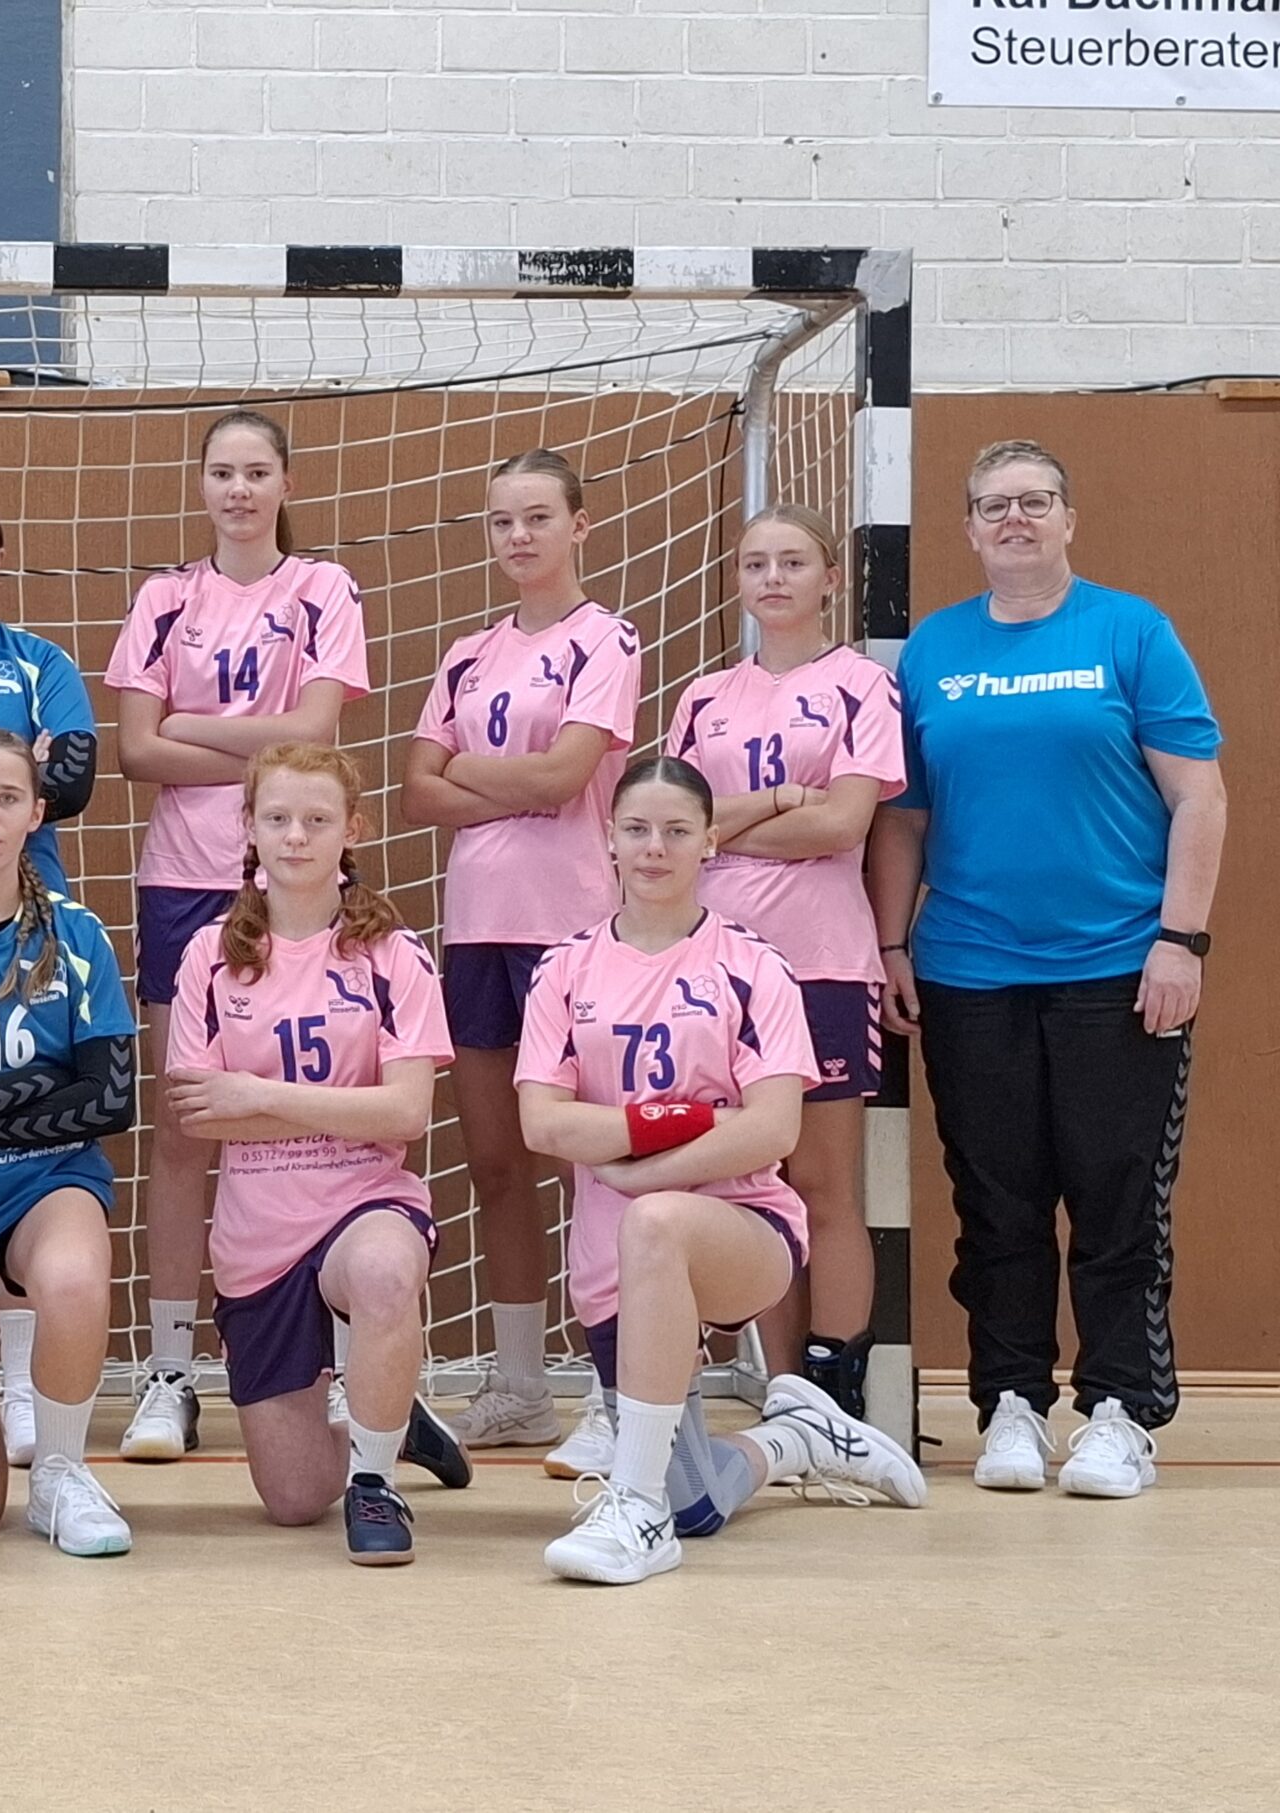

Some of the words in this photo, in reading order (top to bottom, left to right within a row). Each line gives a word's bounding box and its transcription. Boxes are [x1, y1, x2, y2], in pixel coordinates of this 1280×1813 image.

[213, 646, 259, 704] 14
[976, 665, 1105, 697] hummel
[487, 691, 512, 748] 8
[744, 733, 787, 792] 13
[273, 1015, 331, 1084] 15
[612, 1022, 675, 1092] 73
